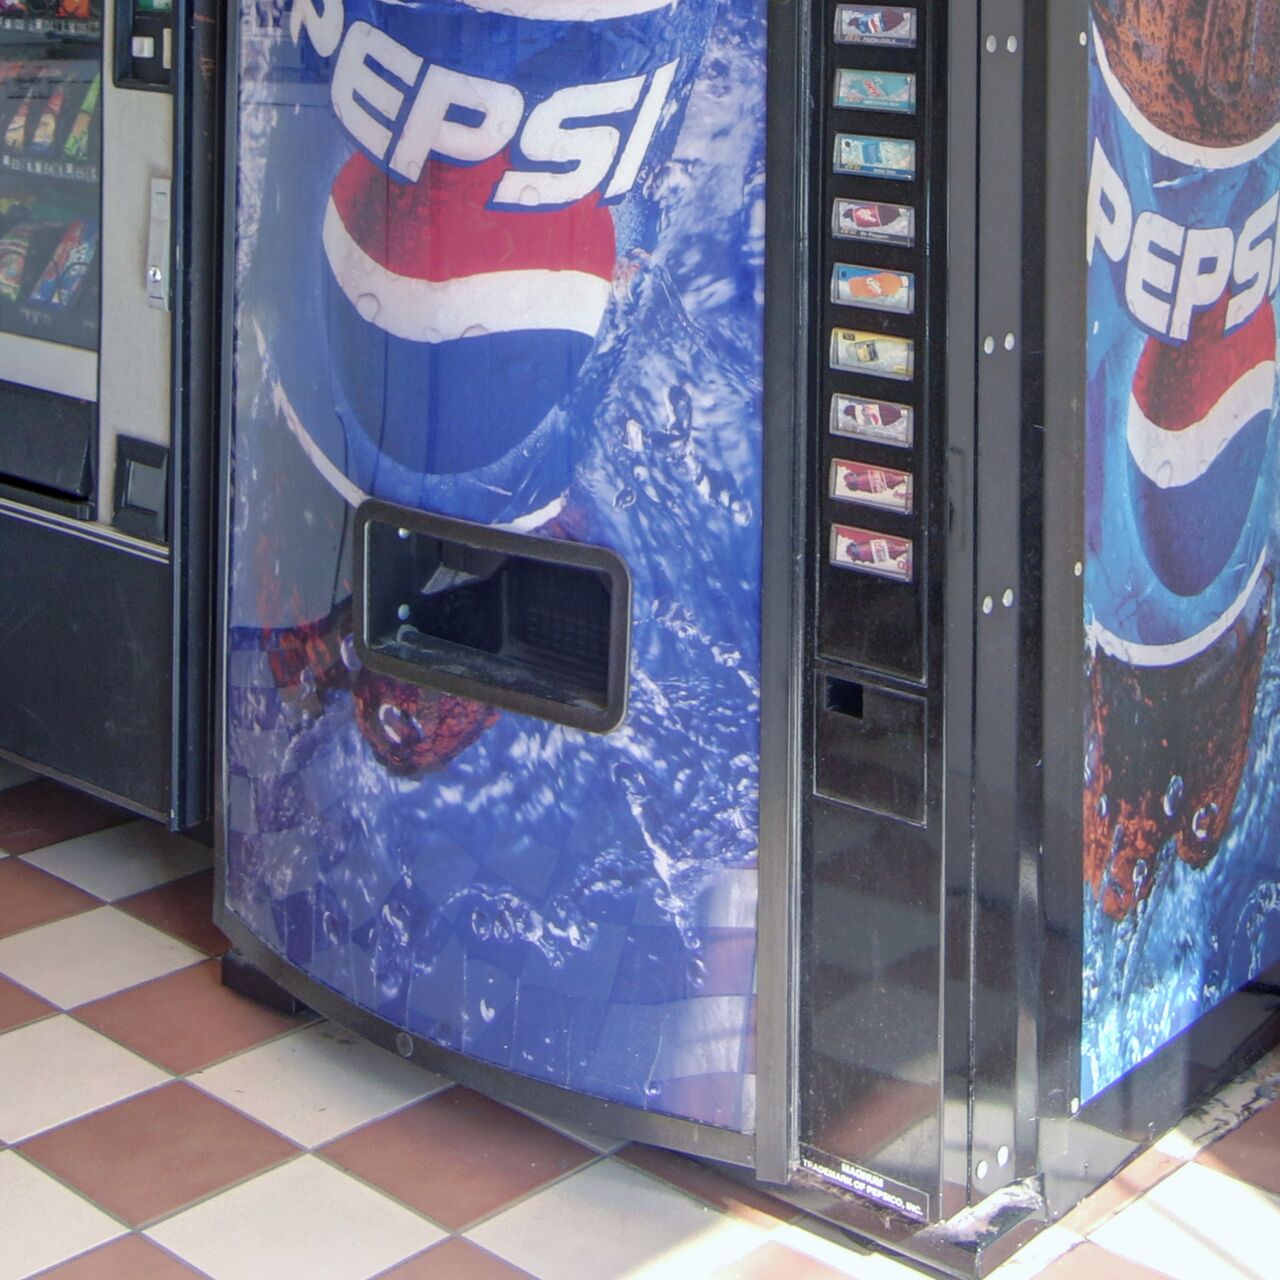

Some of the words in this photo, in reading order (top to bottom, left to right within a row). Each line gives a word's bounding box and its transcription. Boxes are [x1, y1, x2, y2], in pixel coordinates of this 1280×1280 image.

[802, 1158, 853, 1186] TRADEMARK
[853, 1180, 866, 1190] OF
[866, 1185, 905, 1210] PEPSICO,
[905, 1201, 924, 1216] INC.
[841, 1163, 884, 1188] MAGNUM
